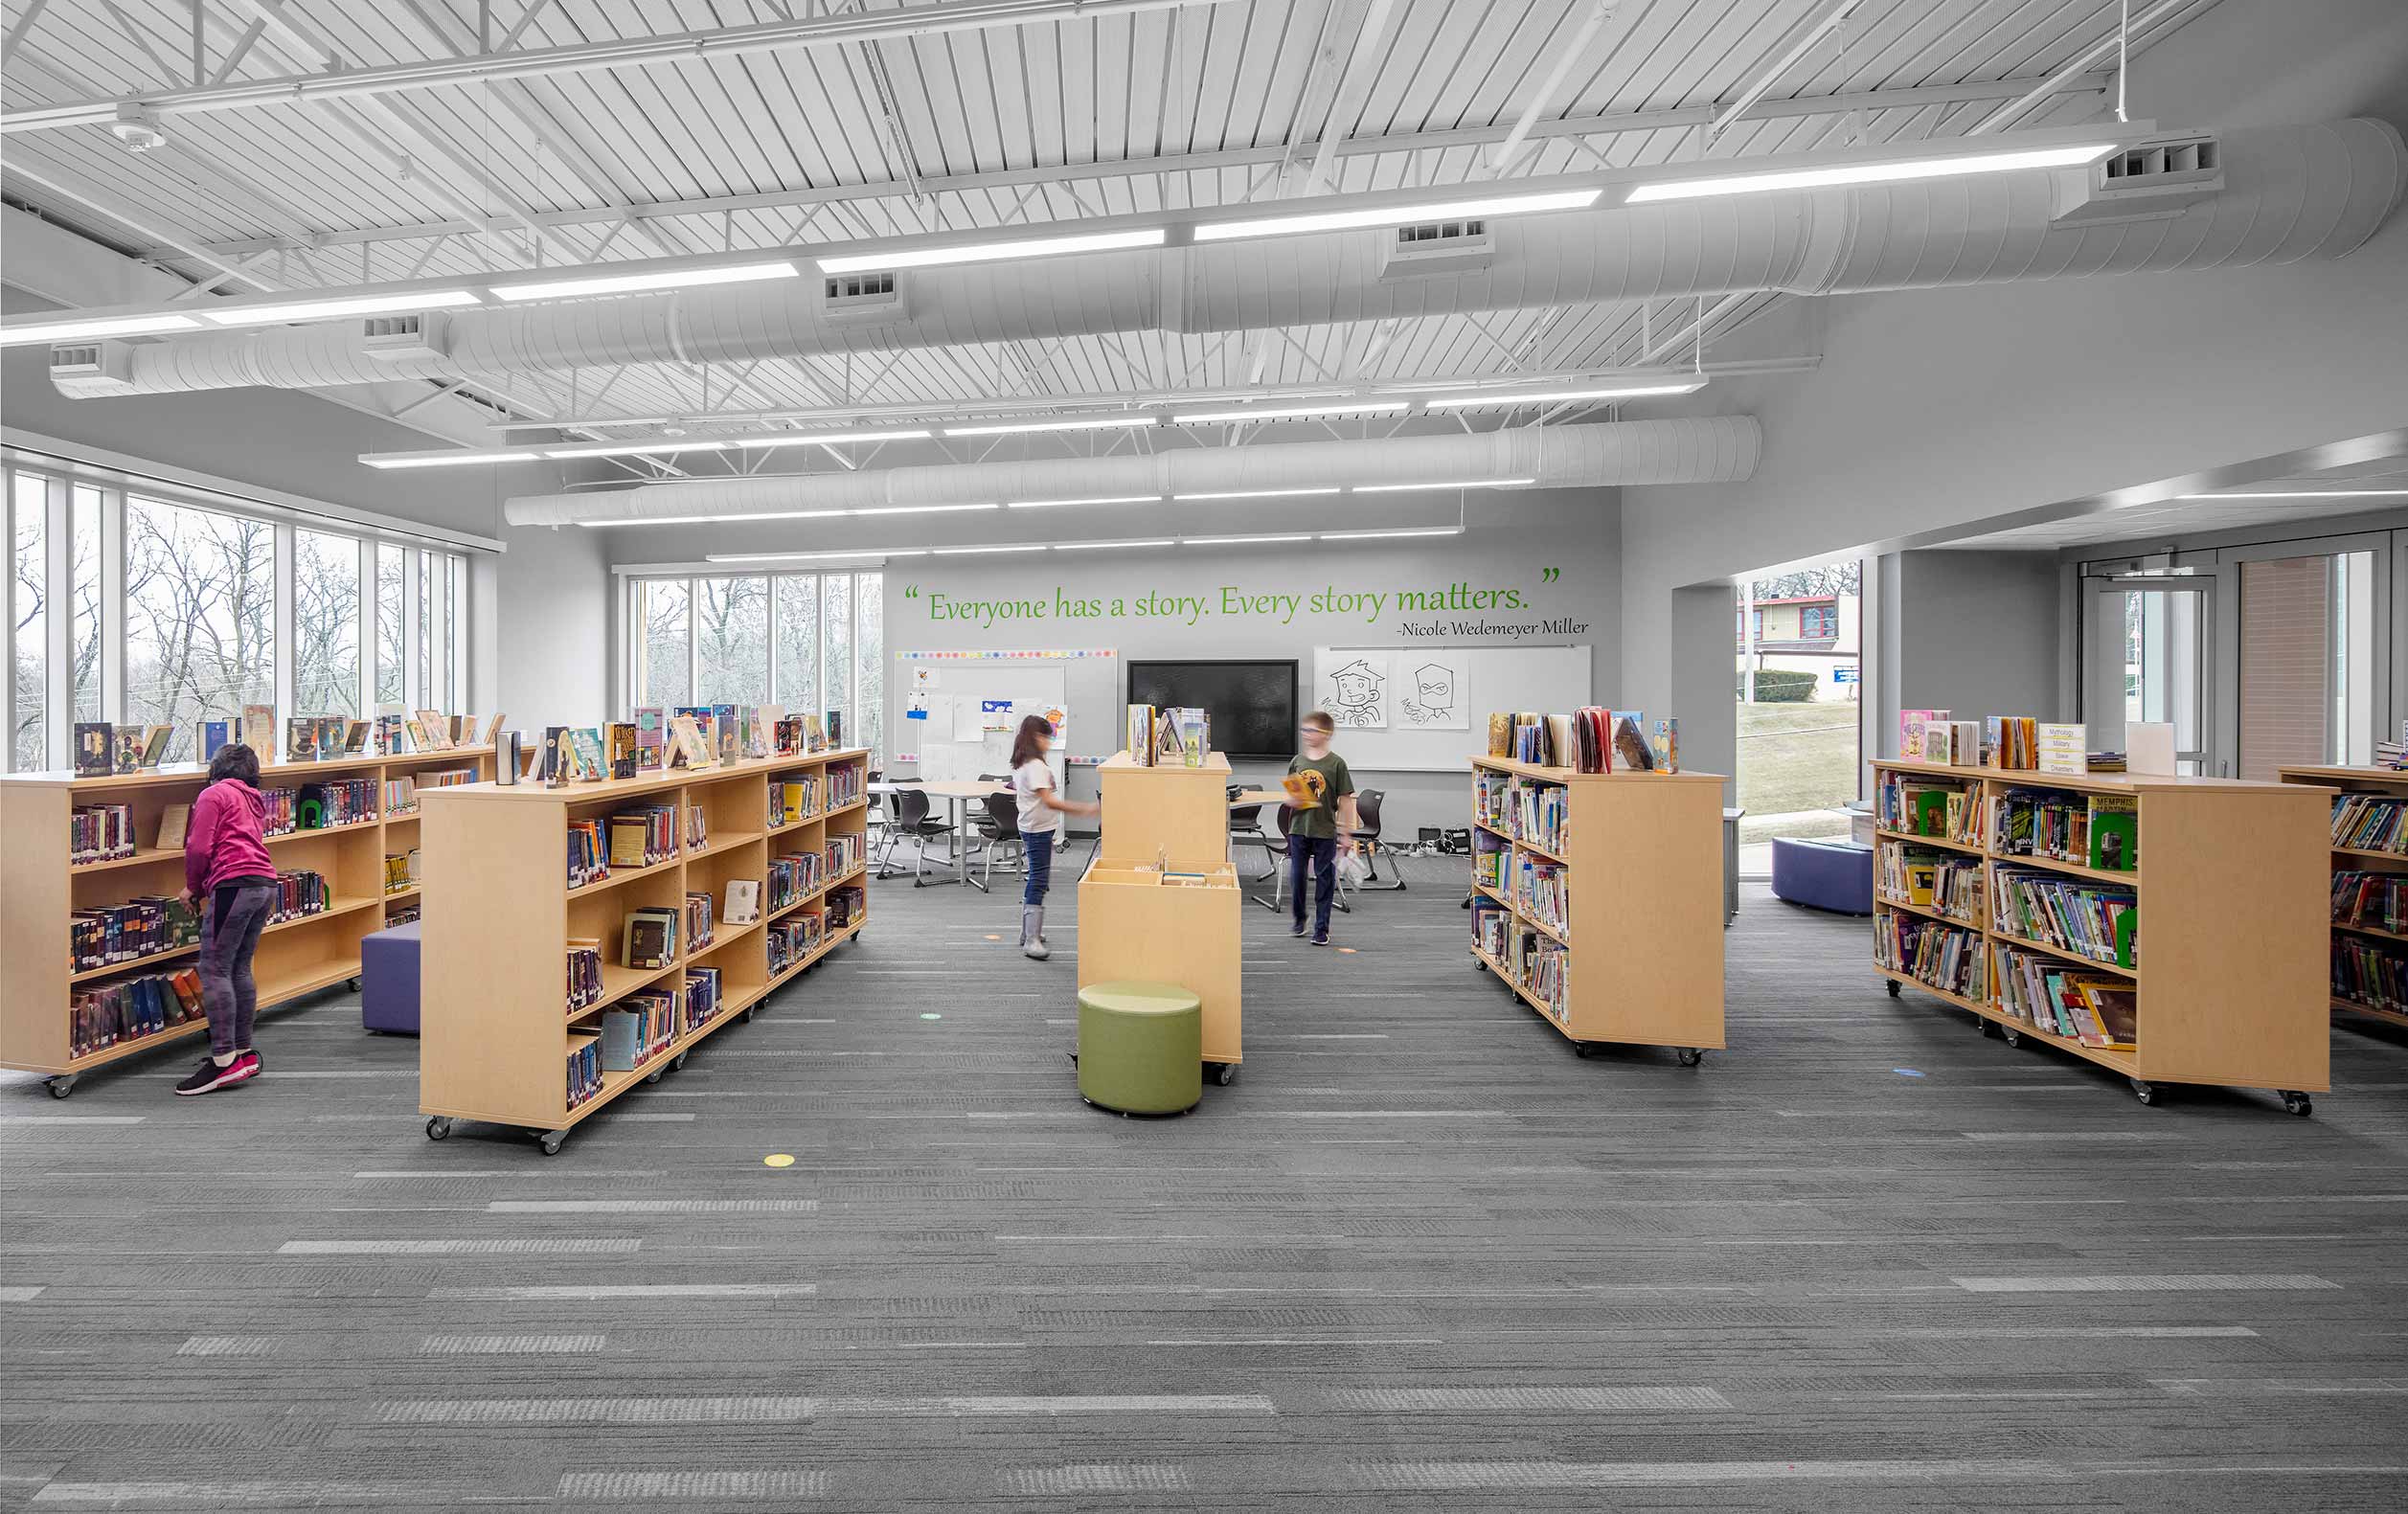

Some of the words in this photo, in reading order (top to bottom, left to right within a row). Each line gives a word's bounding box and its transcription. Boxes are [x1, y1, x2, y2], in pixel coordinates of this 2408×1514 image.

[1056, 586, 1102, 618] has
[1109, 597, 1125, 618] a
[1135, 591, 1210, 626] story.
[1218, 586, 1301, 625] Every
[1309, 585, 1388, 623] story
[1396, 620, 1447, 636] -Nicole
[1450, 619, 1539, 640] Wedemeyer
[1541, 618, 1589, 635] Miller
[2048, 729, 2074, 737] Mythology
[2053, 739, 2071, 749] Military
[2050, 764, 2075, 773] Disasters
[2096, 797, 2134, 805] MEMPHIS
